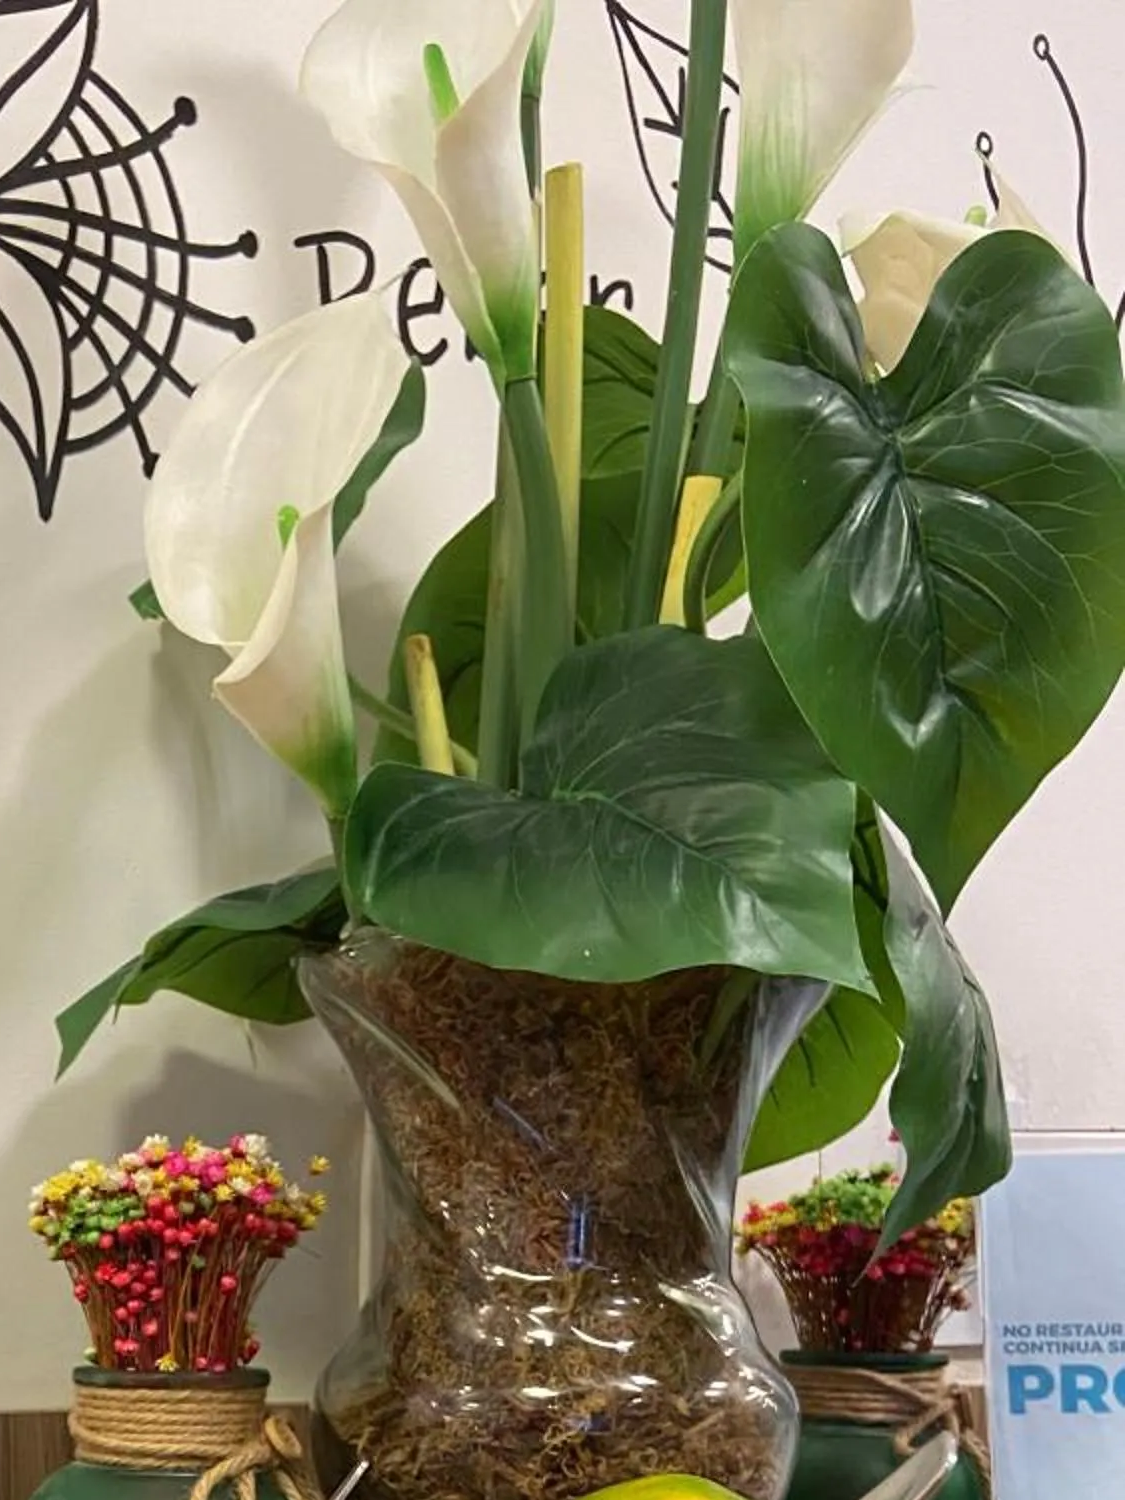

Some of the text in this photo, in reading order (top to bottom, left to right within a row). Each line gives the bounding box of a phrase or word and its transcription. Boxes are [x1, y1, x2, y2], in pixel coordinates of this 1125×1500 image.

[1003, 1323, 1123, 1338] NO RESTAUR
[1003, 1341, 1104, 1354] CONTINUA
[1007, 1364, 1125, 1415] PR
